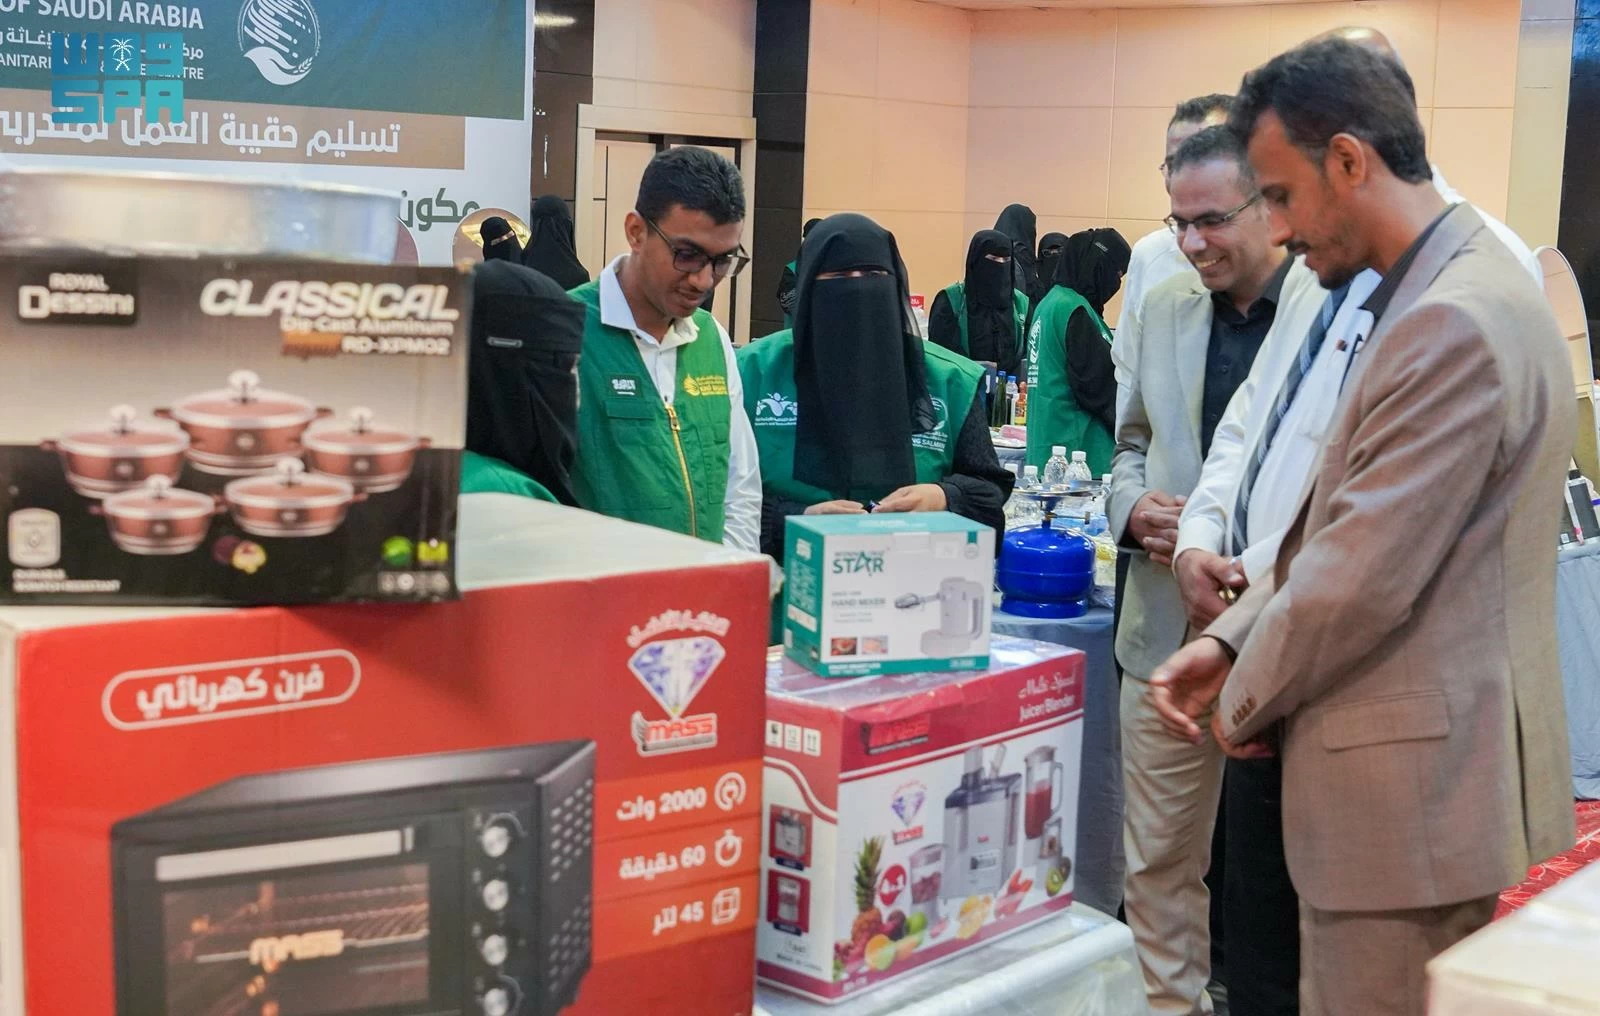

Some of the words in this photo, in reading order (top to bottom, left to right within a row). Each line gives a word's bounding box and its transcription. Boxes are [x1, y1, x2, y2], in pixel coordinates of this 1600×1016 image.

[38, 0, 112, 21] SAUDI
[118, 1, 205, 30] ARABIA
[121, 107, 209, 146] العمل
[219, 112, 298, 155] حقيبة
[306, 120, 401, 158] تسليم
[49, 272, 110, 292] ROYAL
[200, 278, 459, 321] CLASSICAL
[832, 550, 884, 575] STAR
[136, 667, 269, 720] كهربائي
[273, 662, 325, 703] فرن
[616, 795, 656, 822] وات
[659, 786, 707, 815] 2000
[619, 851, 679, 881] دقيقة
[681, 845, 706, 868] 60
[652, 904, 678, 936] لتر
[680, 900, 704, 923] 45
